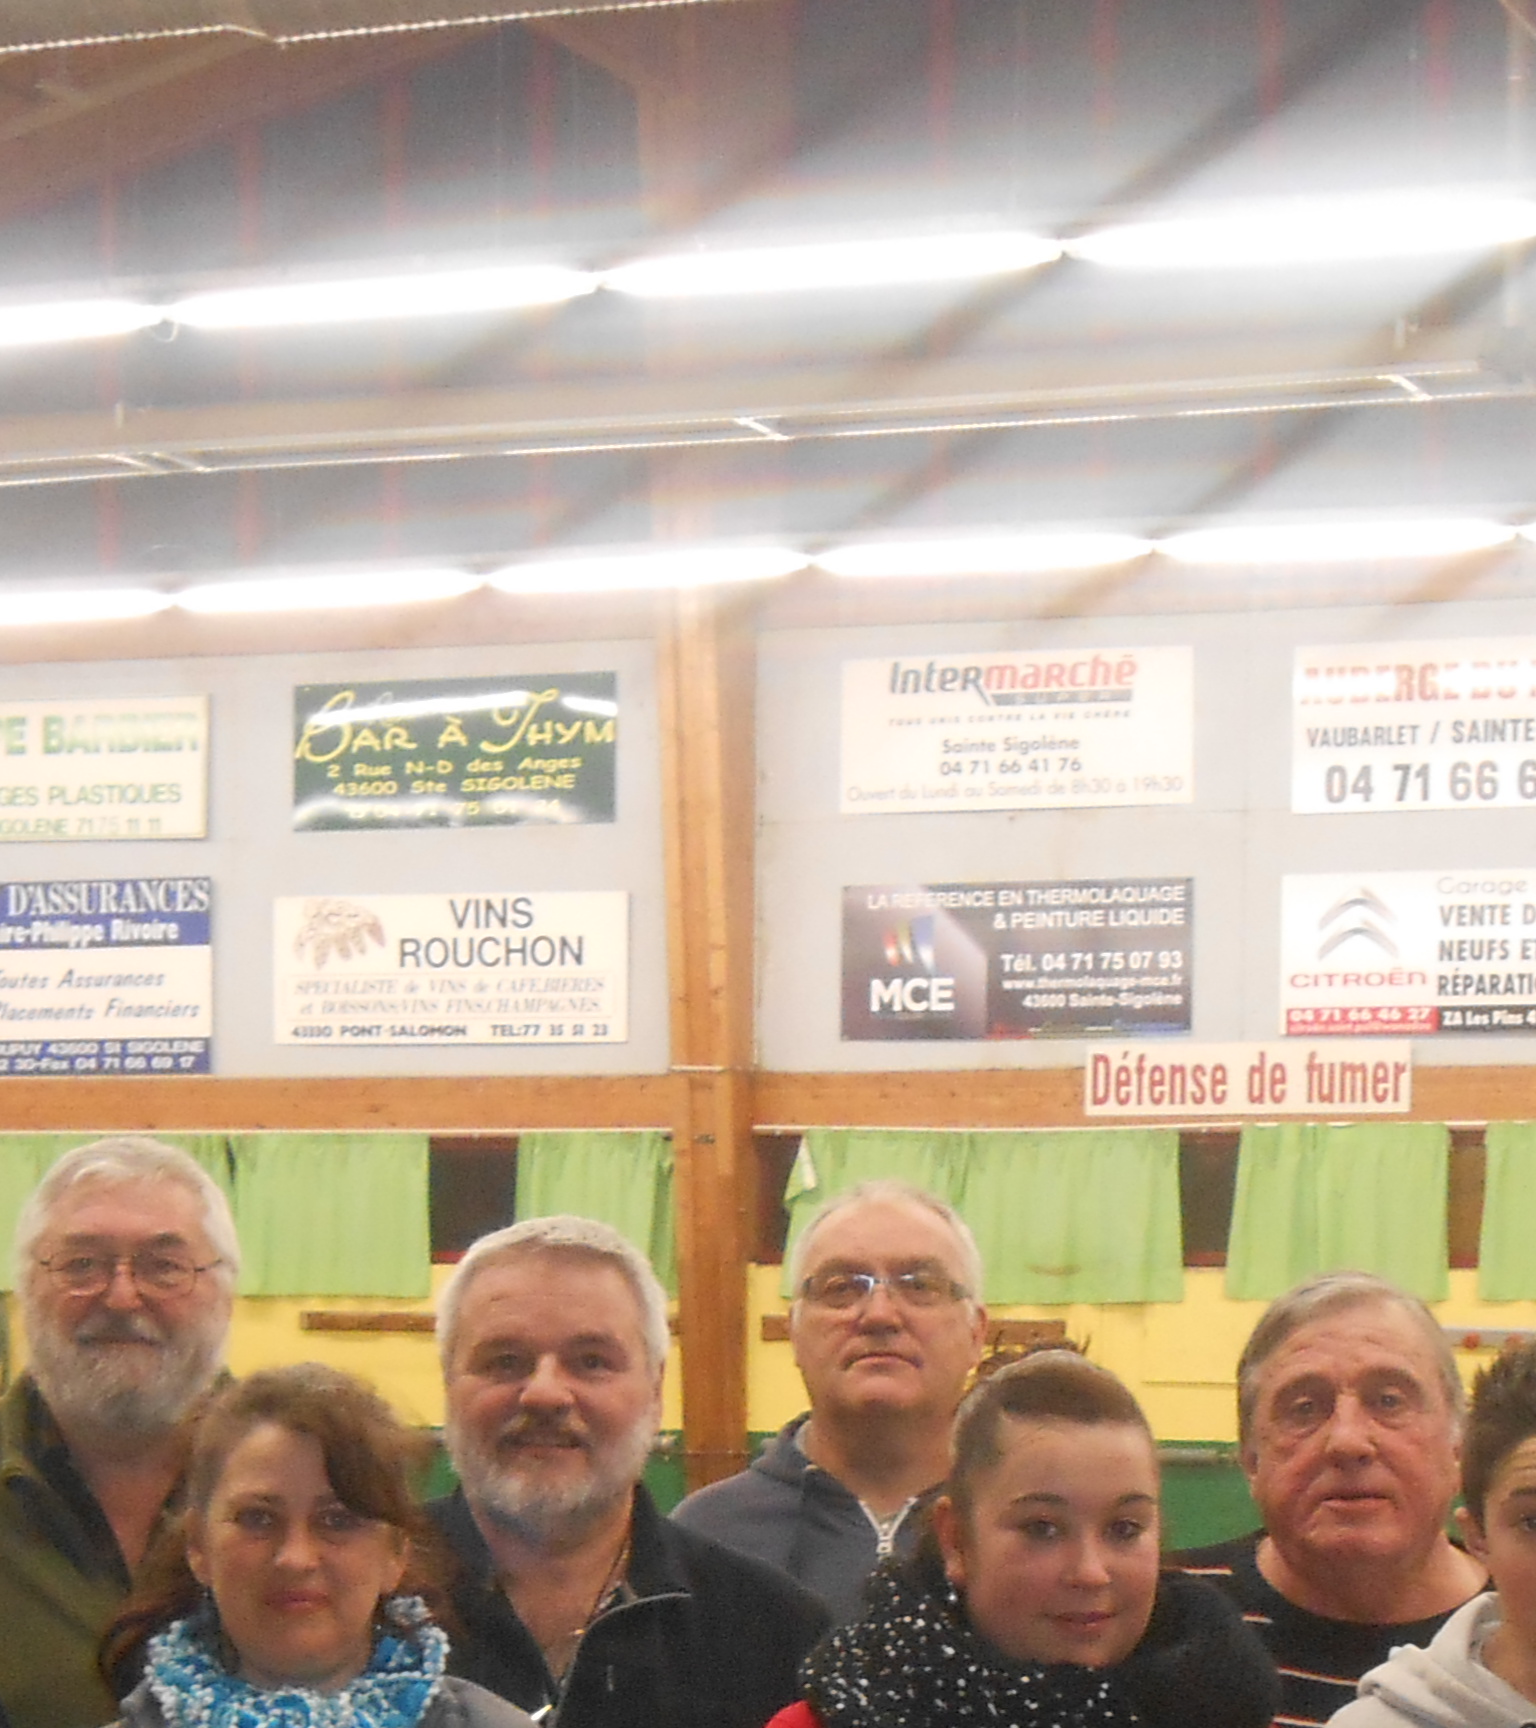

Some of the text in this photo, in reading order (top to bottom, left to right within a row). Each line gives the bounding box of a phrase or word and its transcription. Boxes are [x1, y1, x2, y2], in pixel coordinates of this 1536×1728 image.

[942, 735, 1080, 755] Sainte Sigolène
[1307, 725, 1419, 748] VAUBARLET
[327, 757, 581, 778] 2 Rue N-D des Anges
[940, 757, 1082, 776] 04 71 66 41 76
[333, 775, 577, 796] 43600 Ste SIGOLENE
[847, 786, 895, 802] Ouvert
[899, 783, 918, 800] du
[988, 778, 1042, 797] Samedi
[1048, 778, 1066, 794] de
[1325, 765, 1374, 803] 04
[1392, 763, 1431, 801] 71
[1449, 761, 1499, 801] 66
[49, 784, 182, 805] PLASTIQUES
[998, 890, 1023, 906] EN
[1026, 885, 1186, 904] THERMOLAQUAGE
[1436, 877, 1528, 896] Garage
[8, 880, 210, 916] D'ASSURANCES
[449, 897, 534, 929] VINS
[993, 908, 1186, 929] & PEINTURE LIQUIDE
[1439, 903, 1511, 926] VENTE
[111, 919, 179, 940] Rivoire
[399, 935, 584, 968] ROUCHON
[1041, 952, 1066, 971] 04
[1071, 952, 1093, 970] 71
[1101, 952, 1124, 970] 75
[1129, 952, 1151, 970] 07
[1159, 951, 1183, 969] 93
[1439, 939, 1510, 962] NEUFS
[57, 968, 165, 988] Assurances
[870, 977, 955, 1013] MCE
[104, 999, 201, 1018] Financiers
[1290, 1008, 1315, 1022] 04
[1320, 1008, 1341, 1021] 71
[1347, 1007, 1372, 1021] 66
[1408, 1006, 1430, 1020] 27
[1442, 1011, 1462, 1026] ZA
[1467, 1010, 1490, 1026] Les
[1492, 1010, 1524, 1026] Pins
[1091, 1051, 1407, 1106] Défense de fumer
